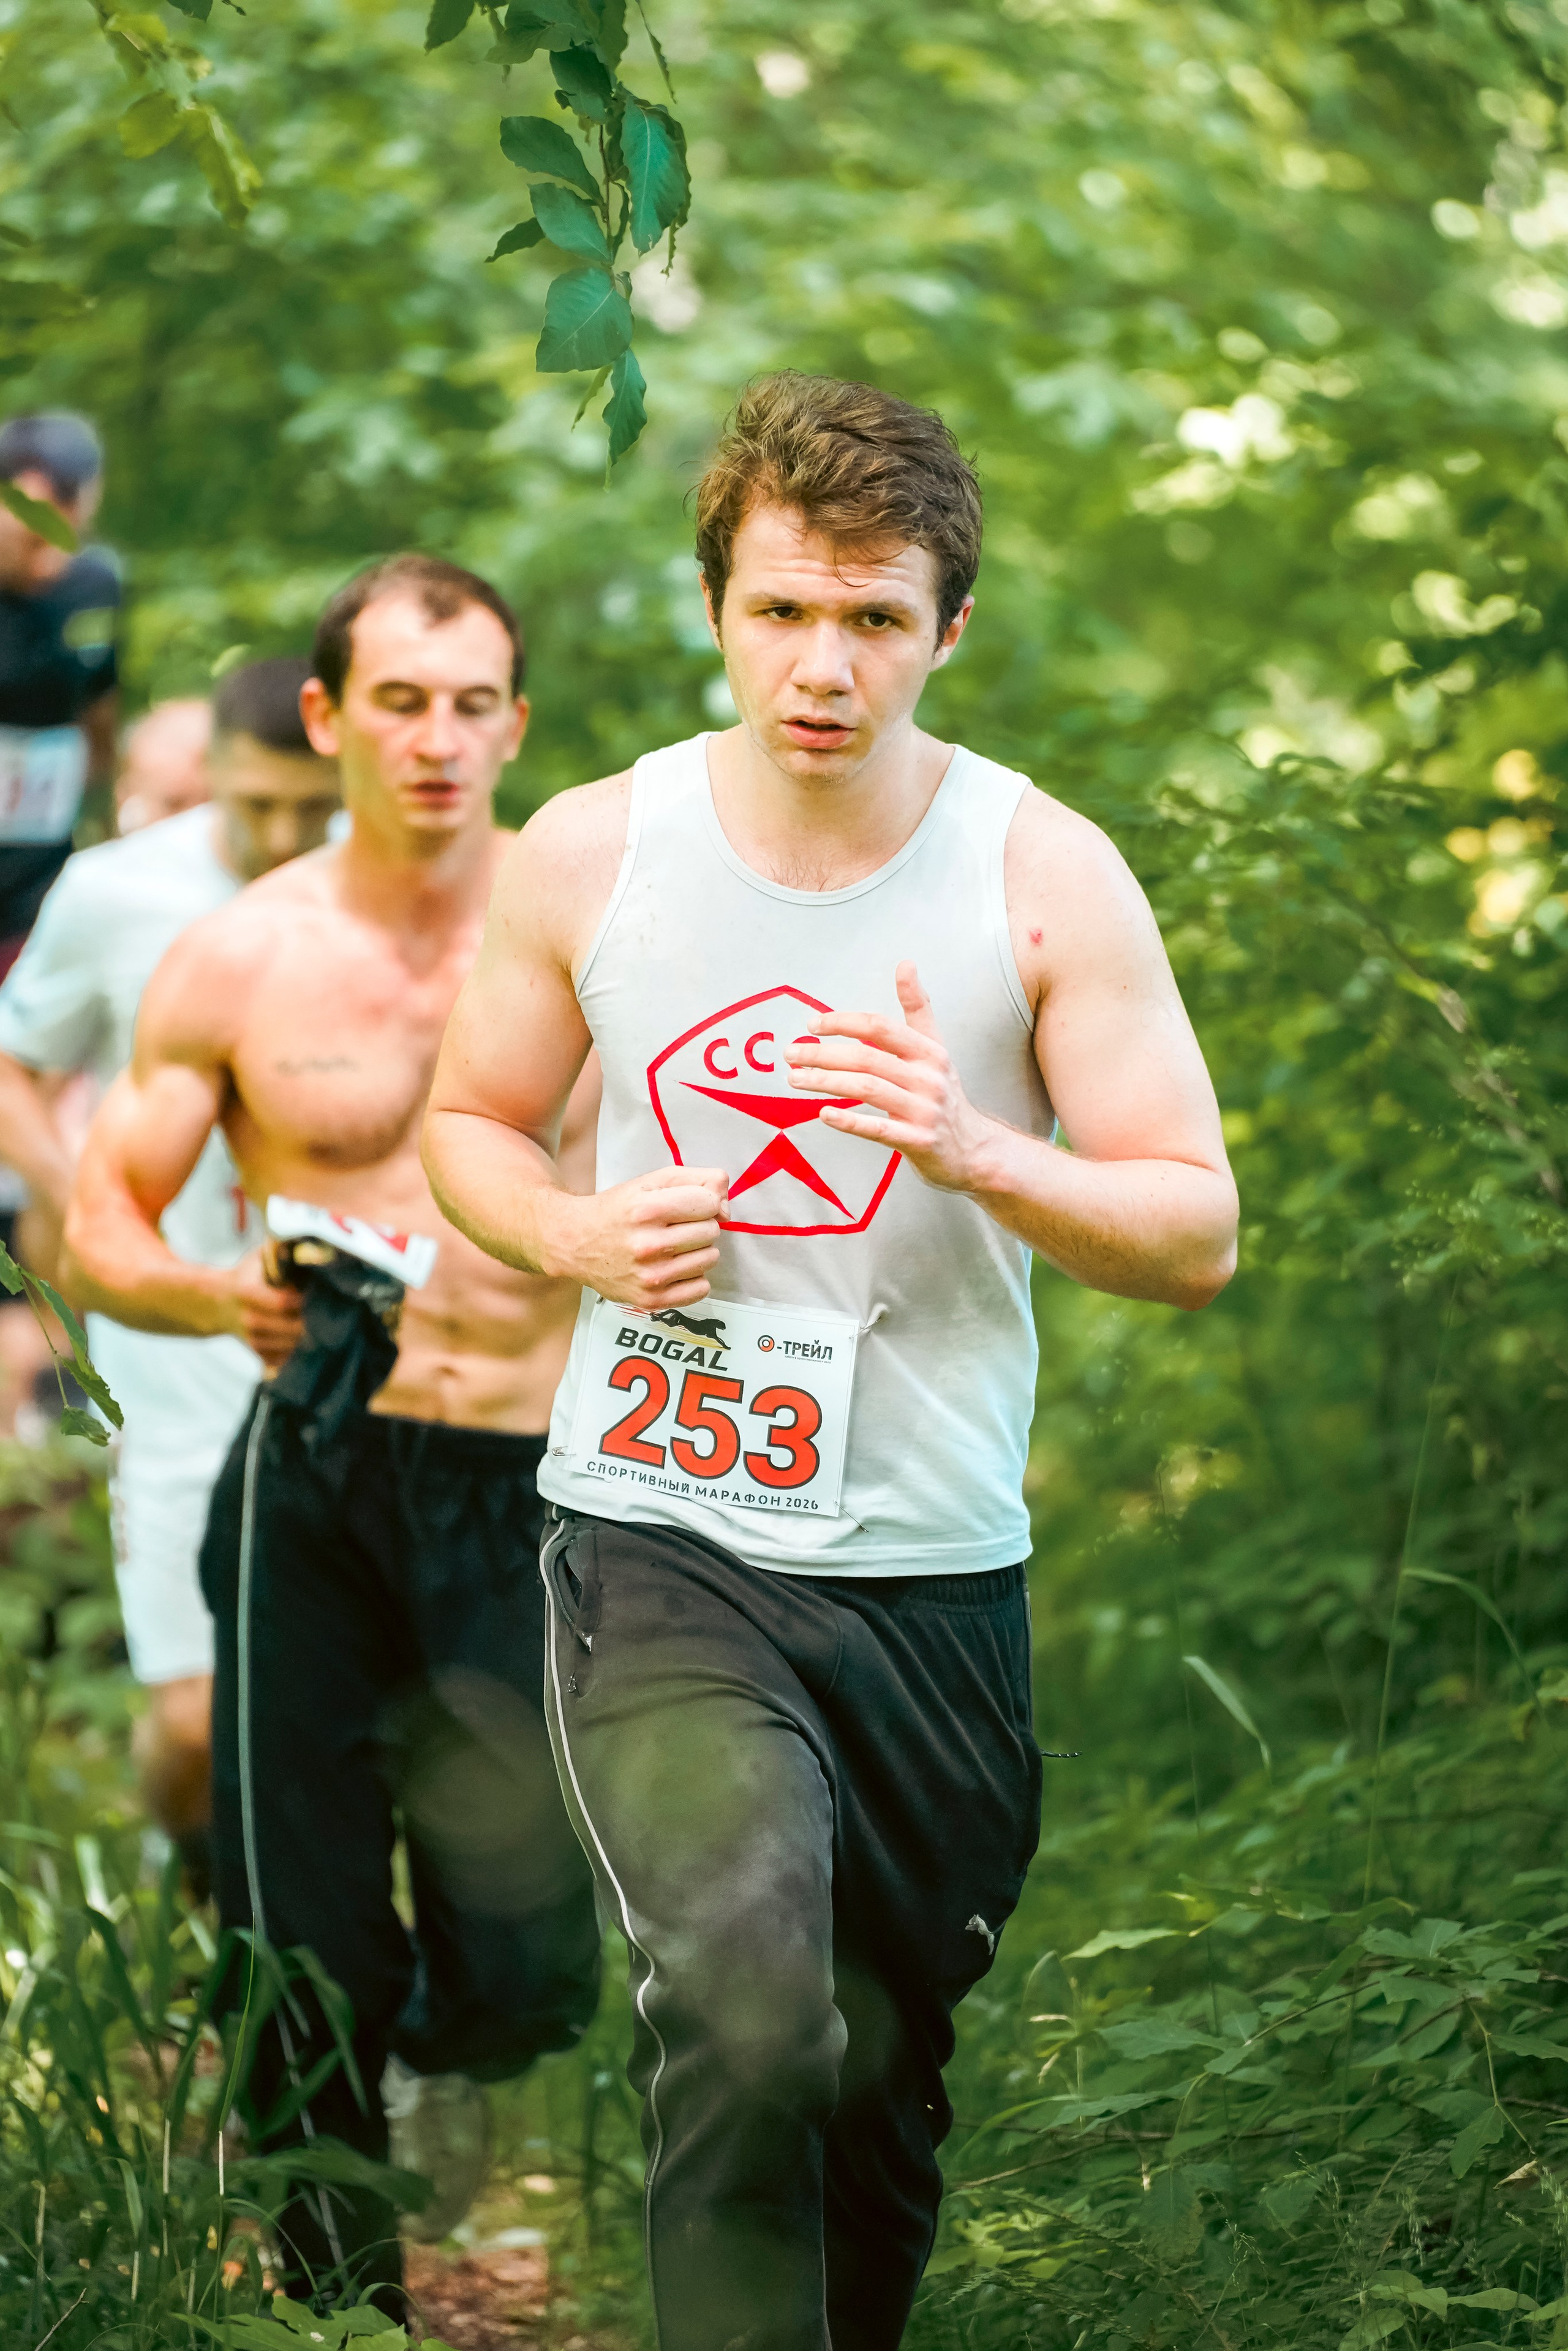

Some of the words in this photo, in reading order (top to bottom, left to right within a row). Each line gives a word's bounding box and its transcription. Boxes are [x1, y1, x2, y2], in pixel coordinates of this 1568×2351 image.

[704, 1032, 821, 1079] СС
[614, 1327, 728, 1372] BOGAL
[598, 1355, 823, 1490] 253
[587, 1461, 690, 1494] СПОРТИВНЫЙ
[695, 1485, 781, 1506] МАРАФОН
[785, 1497, 818, 1510] 2026
